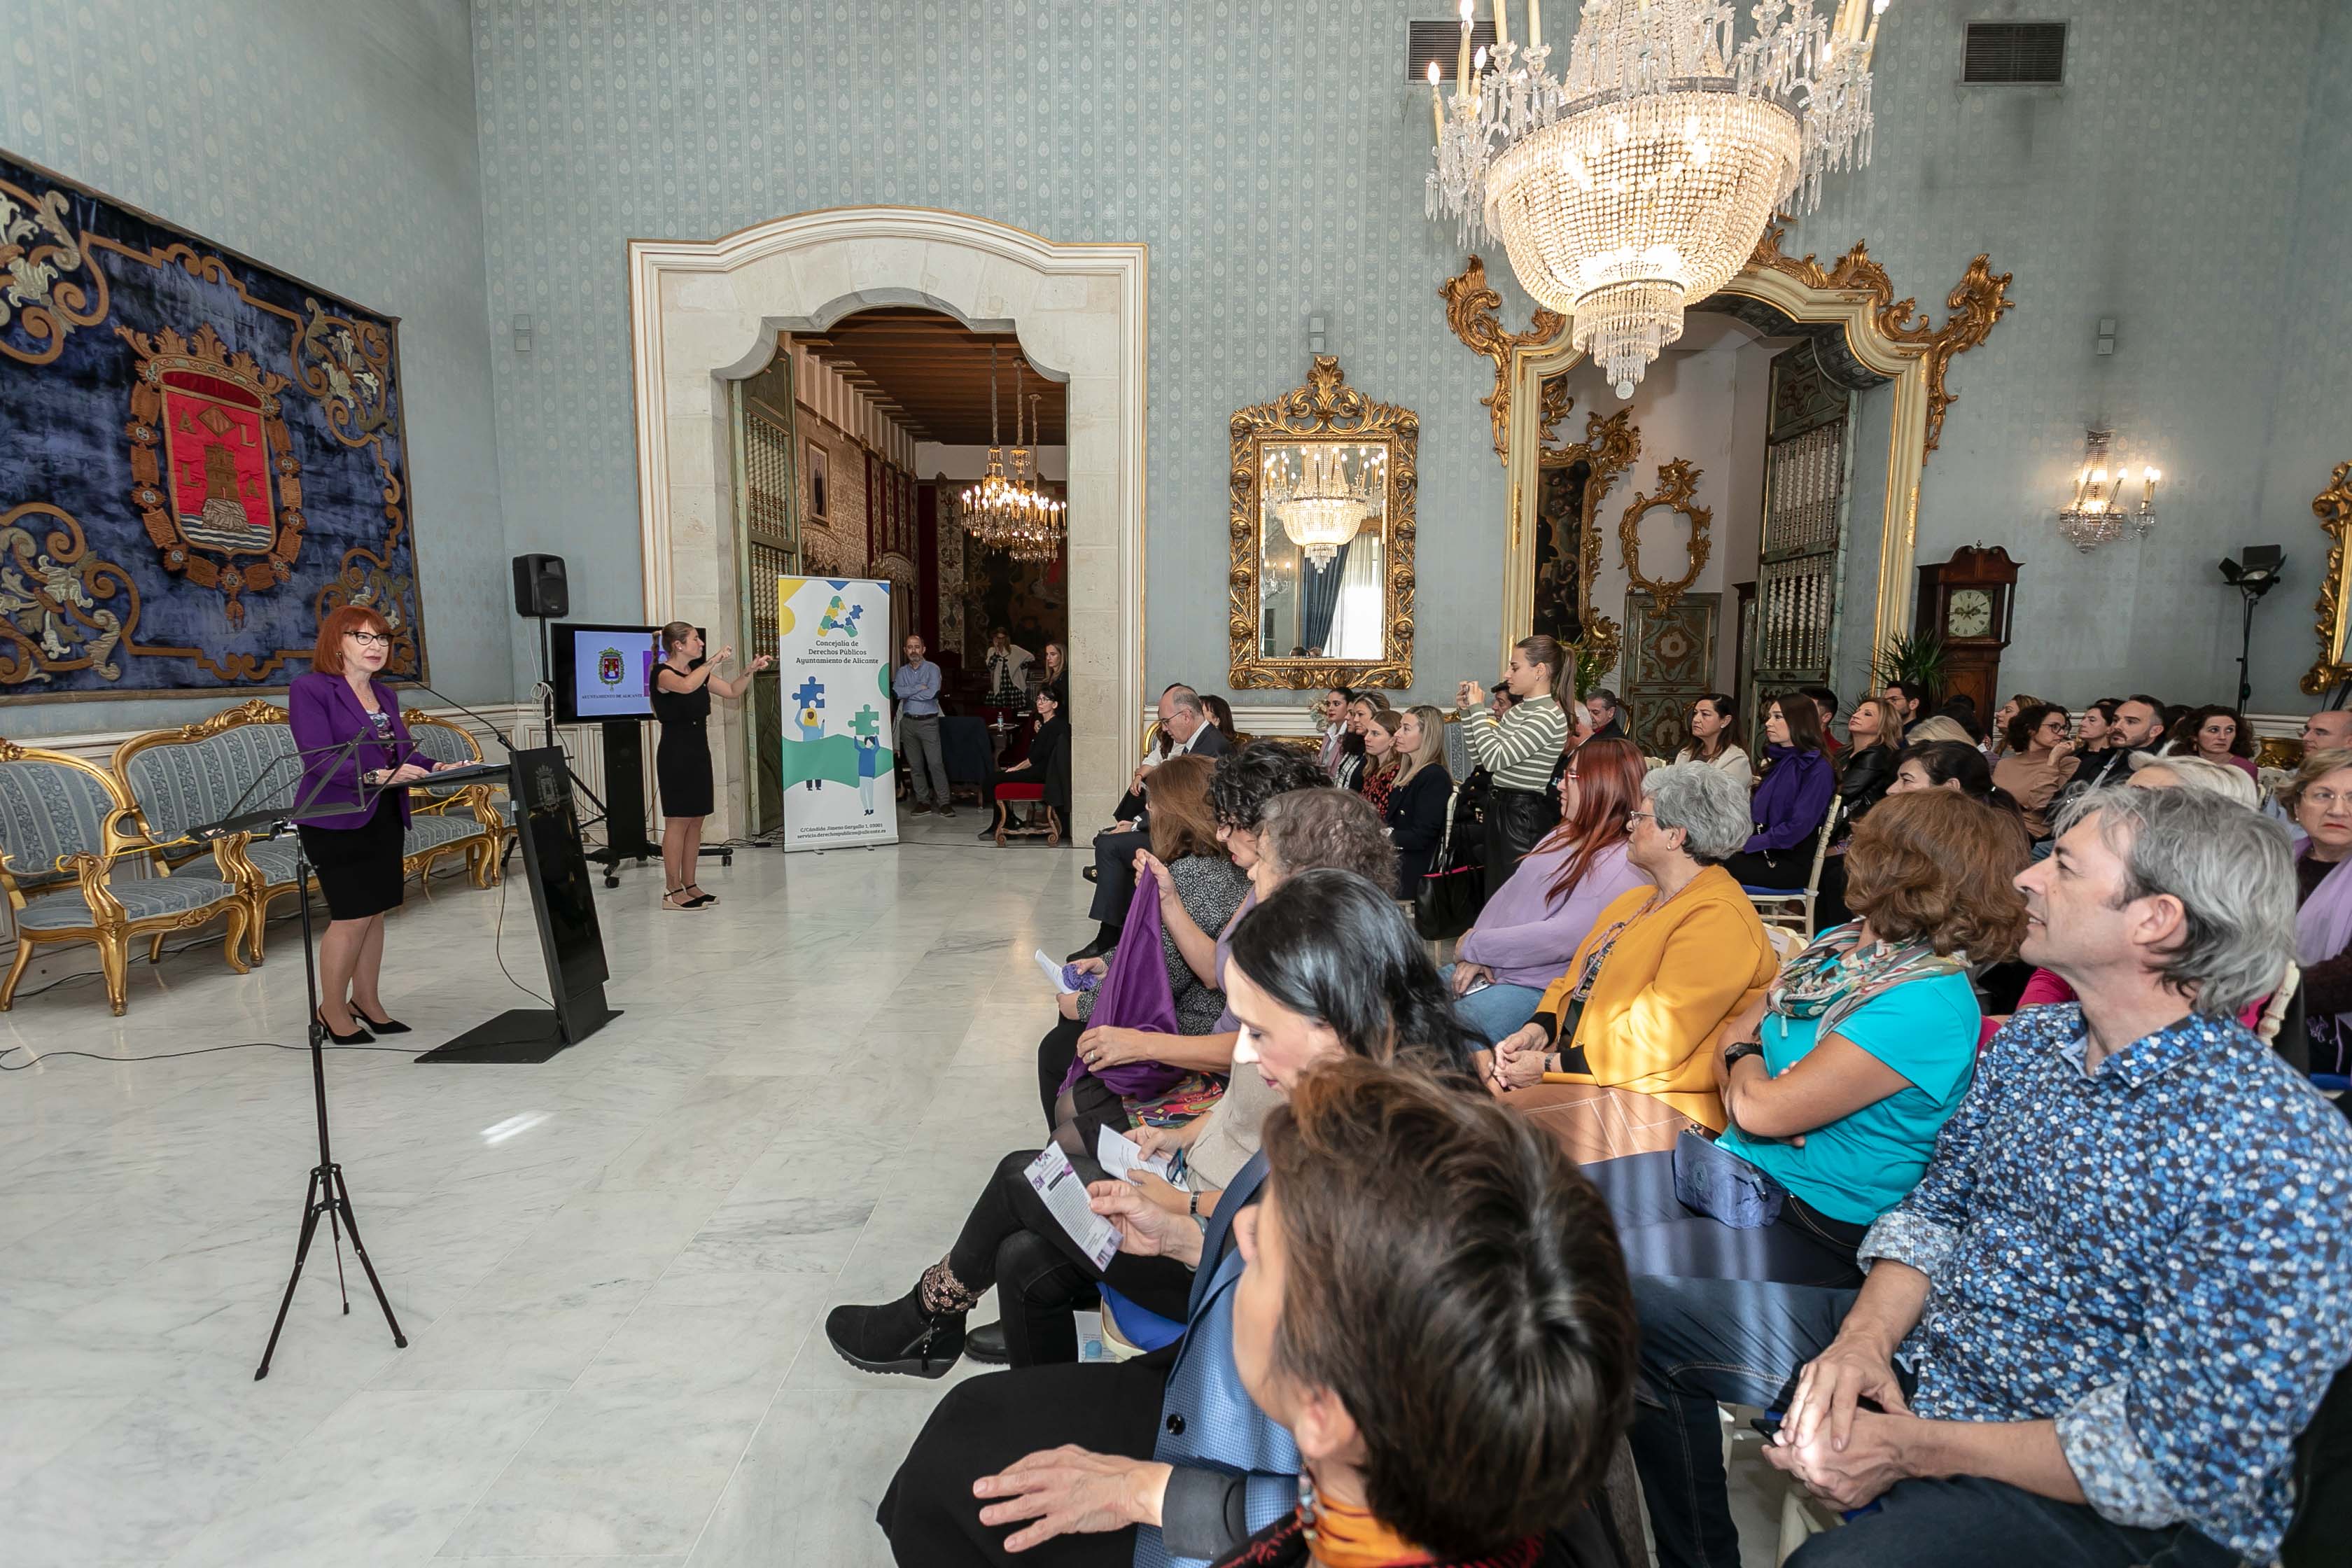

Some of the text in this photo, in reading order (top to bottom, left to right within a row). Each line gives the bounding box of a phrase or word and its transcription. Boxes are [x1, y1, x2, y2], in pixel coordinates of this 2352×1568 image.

[178, 407, 257, 448] A L
[181, 462, 261, 499] L A
